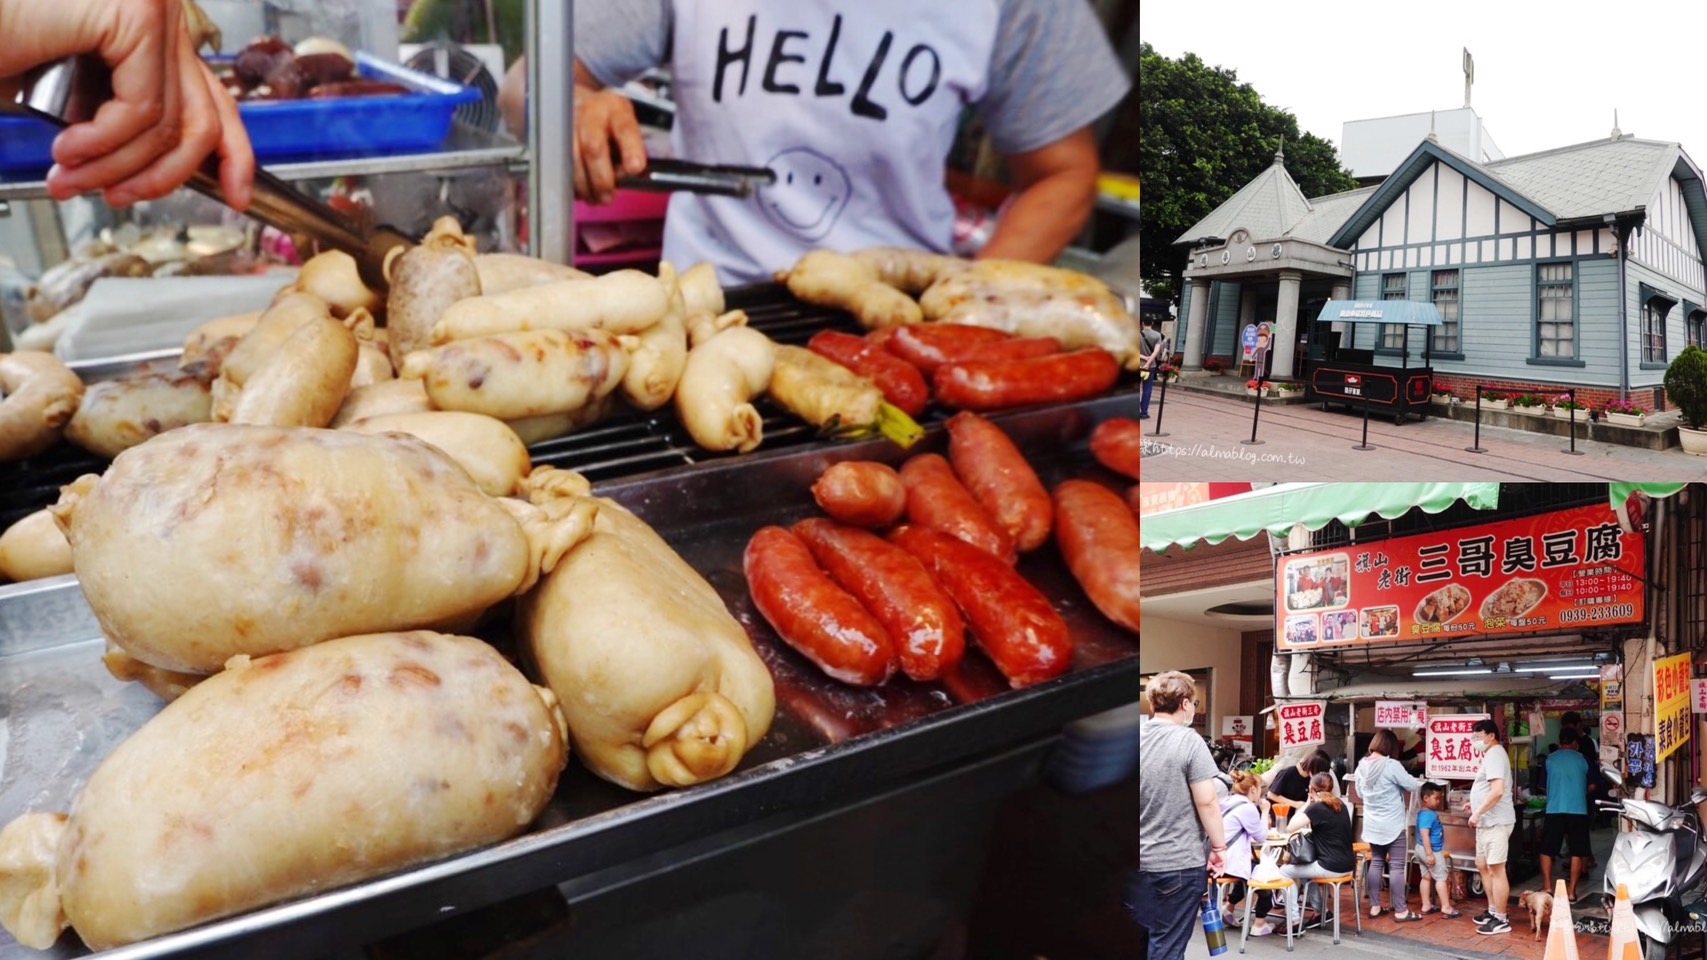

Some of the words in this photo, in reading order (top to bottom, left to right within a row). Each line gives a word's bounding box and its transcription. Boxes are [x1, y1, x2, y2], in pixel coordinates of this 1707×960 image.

[713, 14, 941, 121] HELLO
[1416, 522, 1623, 583] 三哥臭豆腐
[1377, 567, 1411, 591] 老街
[1560, 603, 1634, 624] 0939-233609
[1284, 718, 1322, 744] 臭豆腐
[1430, 737, 1473, 762] 臭豆腐
